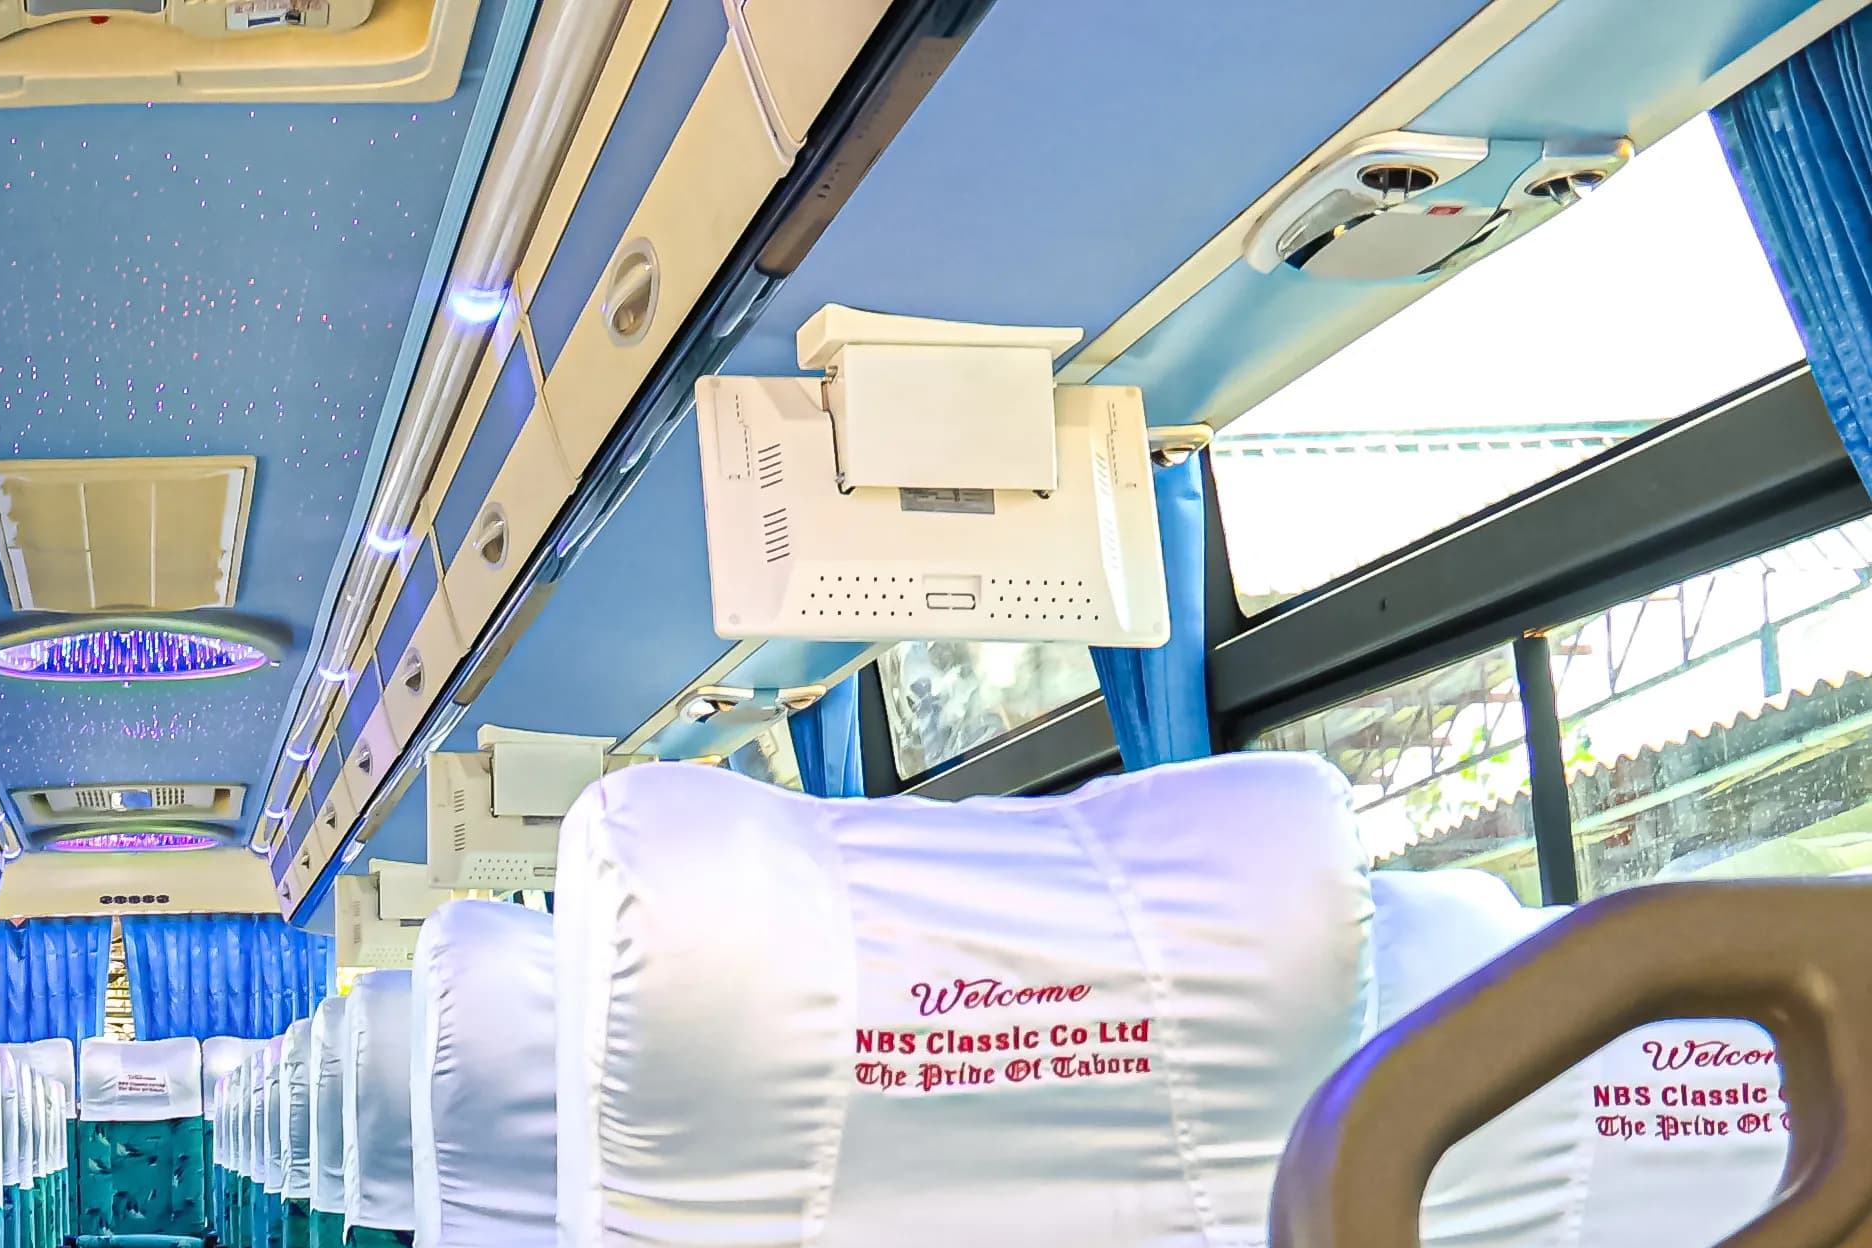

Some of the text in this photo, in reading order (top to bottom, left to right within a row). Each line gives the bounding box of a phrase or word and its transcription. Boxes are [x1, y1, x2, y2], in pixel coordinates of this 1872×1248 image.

[911, 979, 1092, 1016] Welcome
[855, 1018, 1150, 1054] NBS Classic Co Ltd
[1643, 1040, 1776, 1071] Welco
[855, 1053, 1151, 1092] The Pride Of Tabora
[1593, 1084, 1651, 1107] NBS
[1661, 1082, 1768, 1107] Classic
[1596, 1114, 1646, 1141] The
[1654, 1114, 1729, 1141] Pride
[1737, 1112, 1772, 1134] Of
